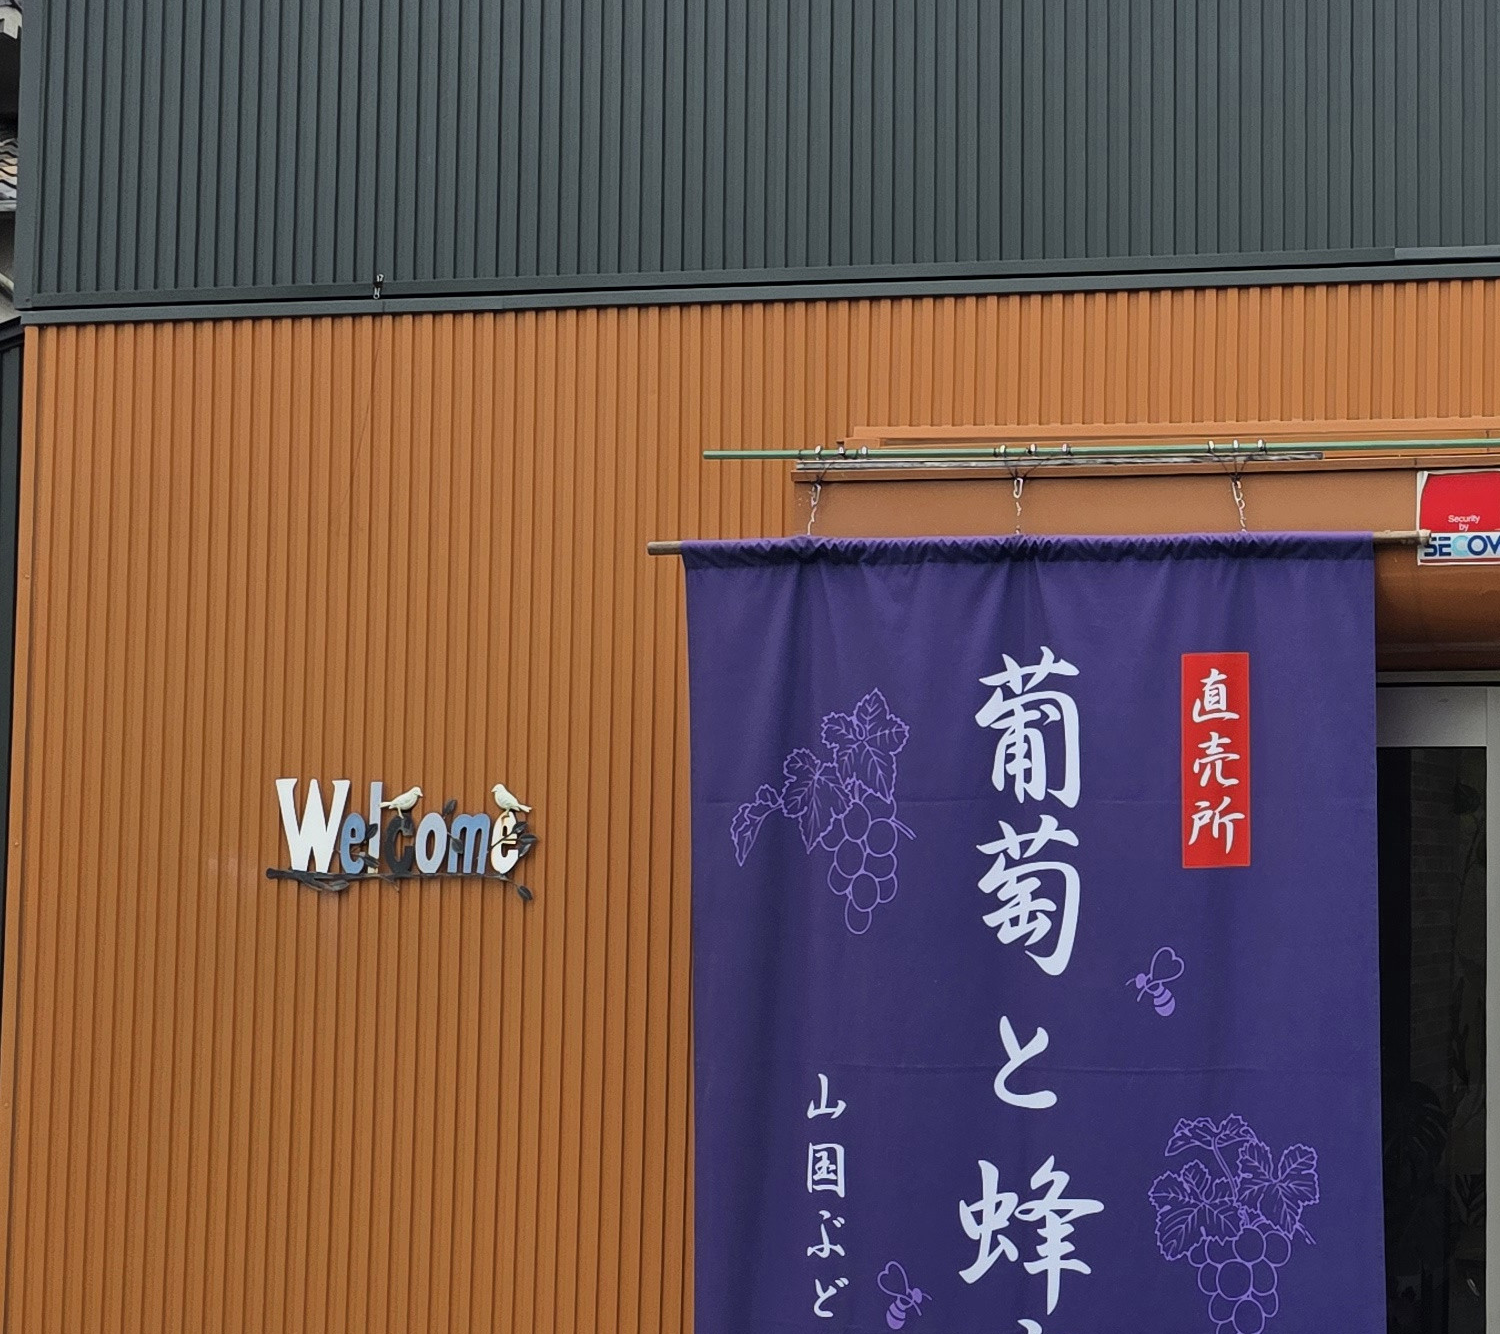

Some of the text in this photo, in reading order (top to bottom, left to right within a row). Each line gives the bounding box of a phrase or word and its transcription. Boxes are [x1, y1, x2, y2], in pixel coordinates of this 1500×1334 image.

[1447, 515, 1481, 524] Security
[1458, 523, 1470, 532] by
[1188, 667, 1246, 855] 直売所
[275, 777, 521, 875] Welcome
